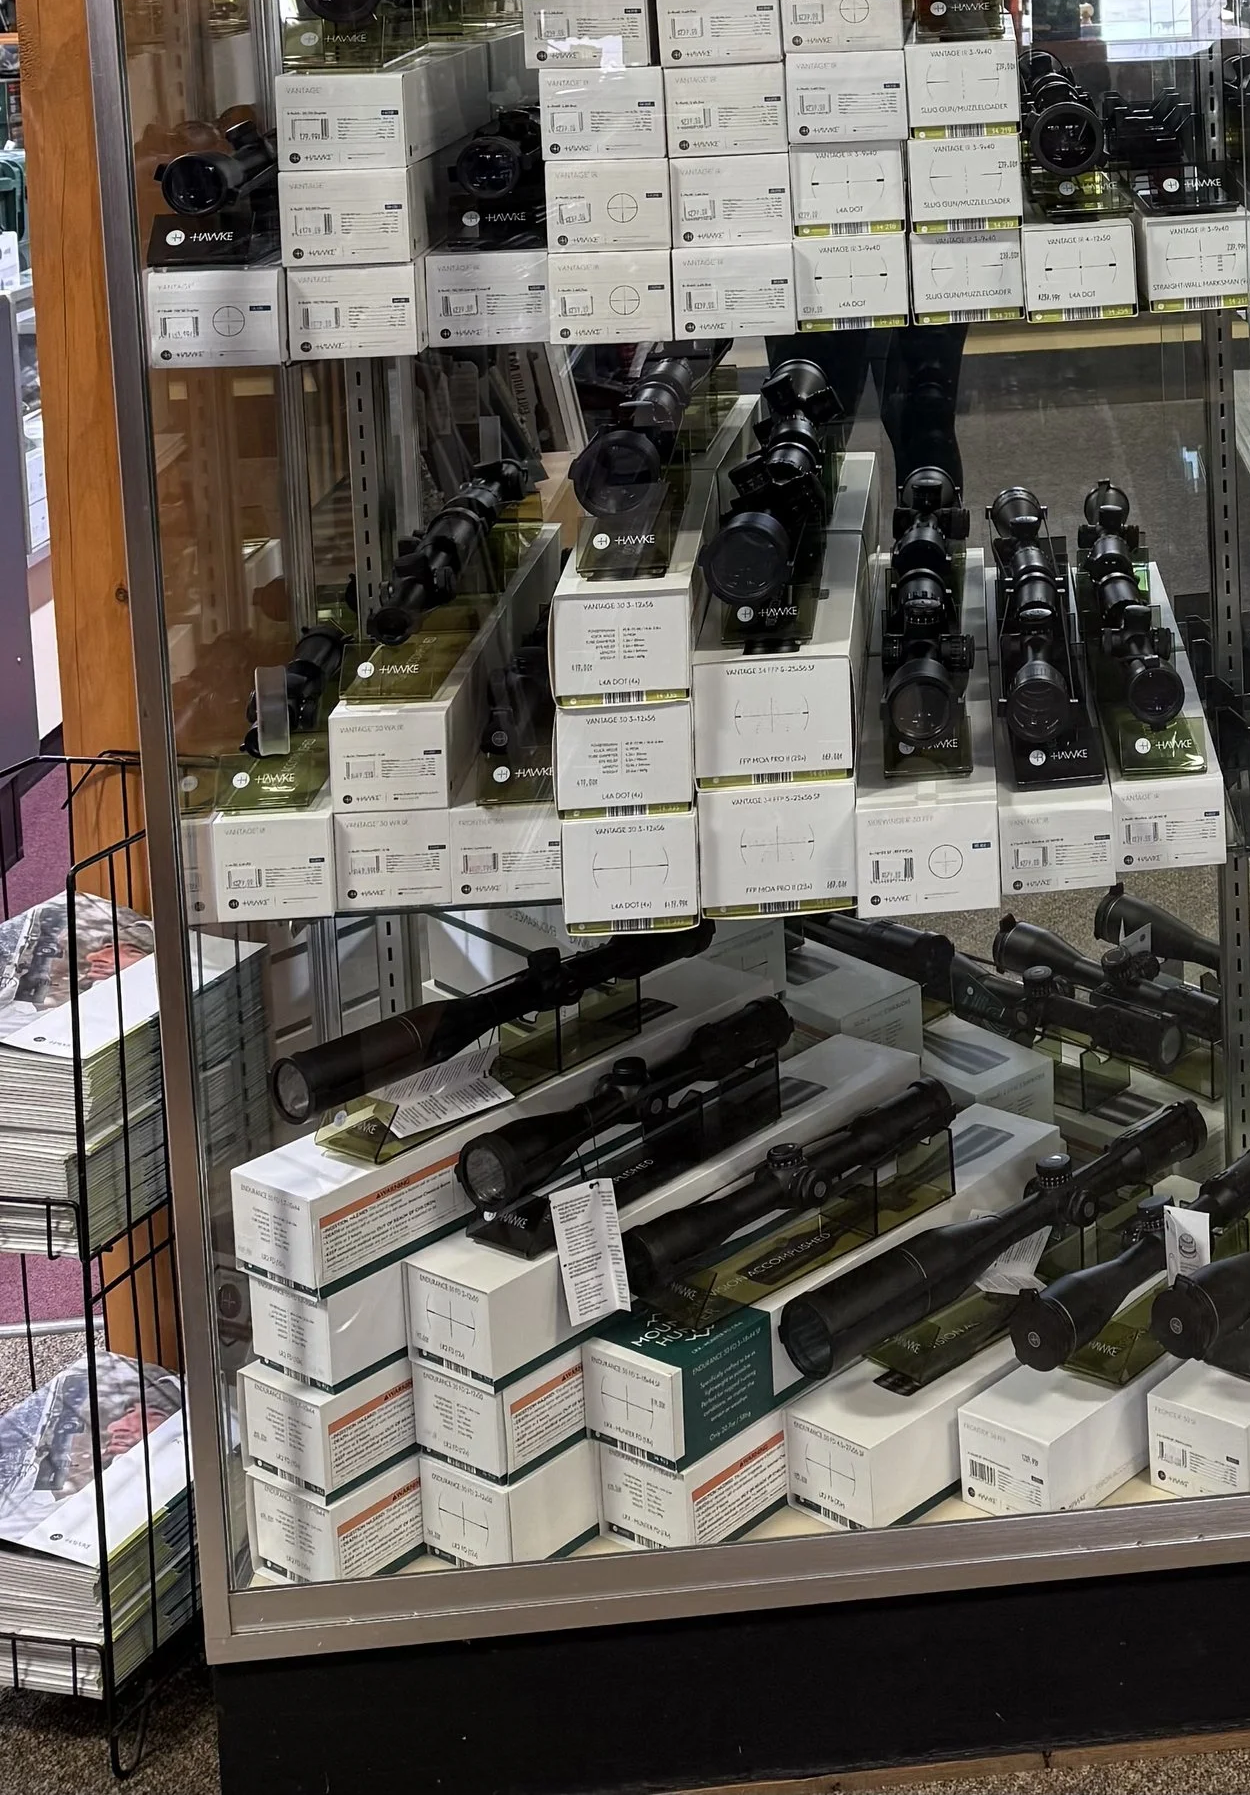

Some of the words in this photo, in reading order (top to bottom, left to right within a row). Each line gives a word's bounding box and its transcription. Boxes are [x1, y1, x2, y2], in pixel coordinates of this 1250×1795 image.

[189, 231, 234, 244] HAWKE
[614, 534, 655, 546] HAWKE
[379, 664, 419, 674] HAWKE
[742, 1231, 831, 1282] ACCOMPLISHED
